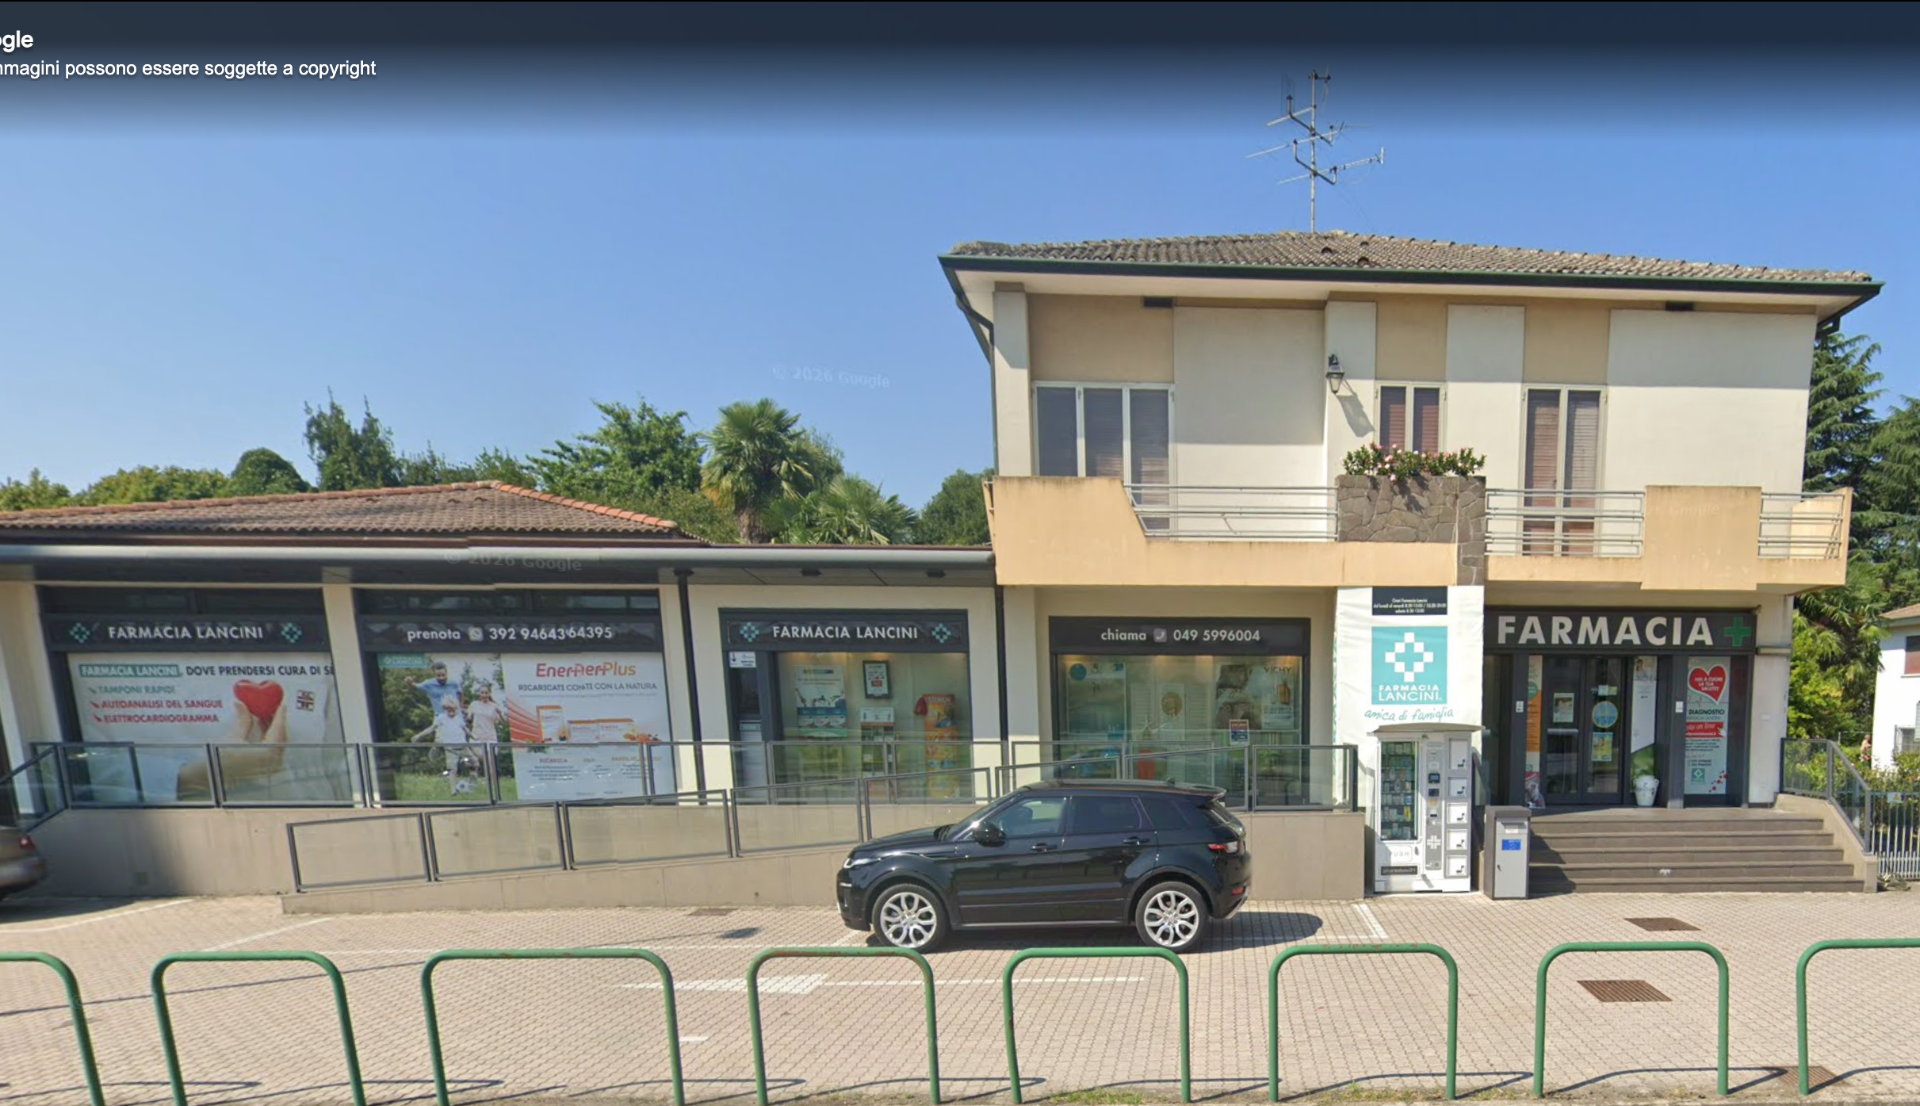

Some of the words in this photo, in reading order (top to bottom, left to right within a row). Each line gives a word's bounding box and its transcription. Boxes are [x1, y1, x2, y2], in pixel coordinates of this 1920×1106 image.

[108, 626, 192, 640] FARMACIA
[197, 625, 264, 639] LANCINI
[407, 629, 460, 642] prenota
[489, 627, 516, 640] 392
[772, 626, 850, 638] FARMACIA
[856, 627, 918, 639] LANCINI
[1101, 628, 1147, 641] chiama
[1173, 630, 1198, 641] 049
[1202, 630, 1260, 641] 5996004
[1497, 615, 1714, 646] FARMACIA
[81, 665, 135, 676] FARMACIA
[186, 666, 216, 676] DOVE
[219, 666, 275, 676] PRENDERSI
[278, 666, 306, 676] CURA
[310, 666, 321, 676] DI
[97, 685, 143, 693] TAMPONI
[144, 685, 175, 693] RAPIDI
[595, 682, 613, 690] CON
[614, 682, 625, 690] LA
[626, 682, 658, 690] NATURA
[1379, 684, 1439, 692] FARMACIA
[101, 700, 163, 709] AUTOANALISI
[166, 700, 182, 708] DEL
[185, 700, 223, 709] SANGUE
[104, 714, 219, 724] ELETTROCARDIOGRAMMA
[1364, 708, 1396, 721] amica
[1398, 709, 1408, 721] di
[1412, 706, 1454, 722] famiglia
